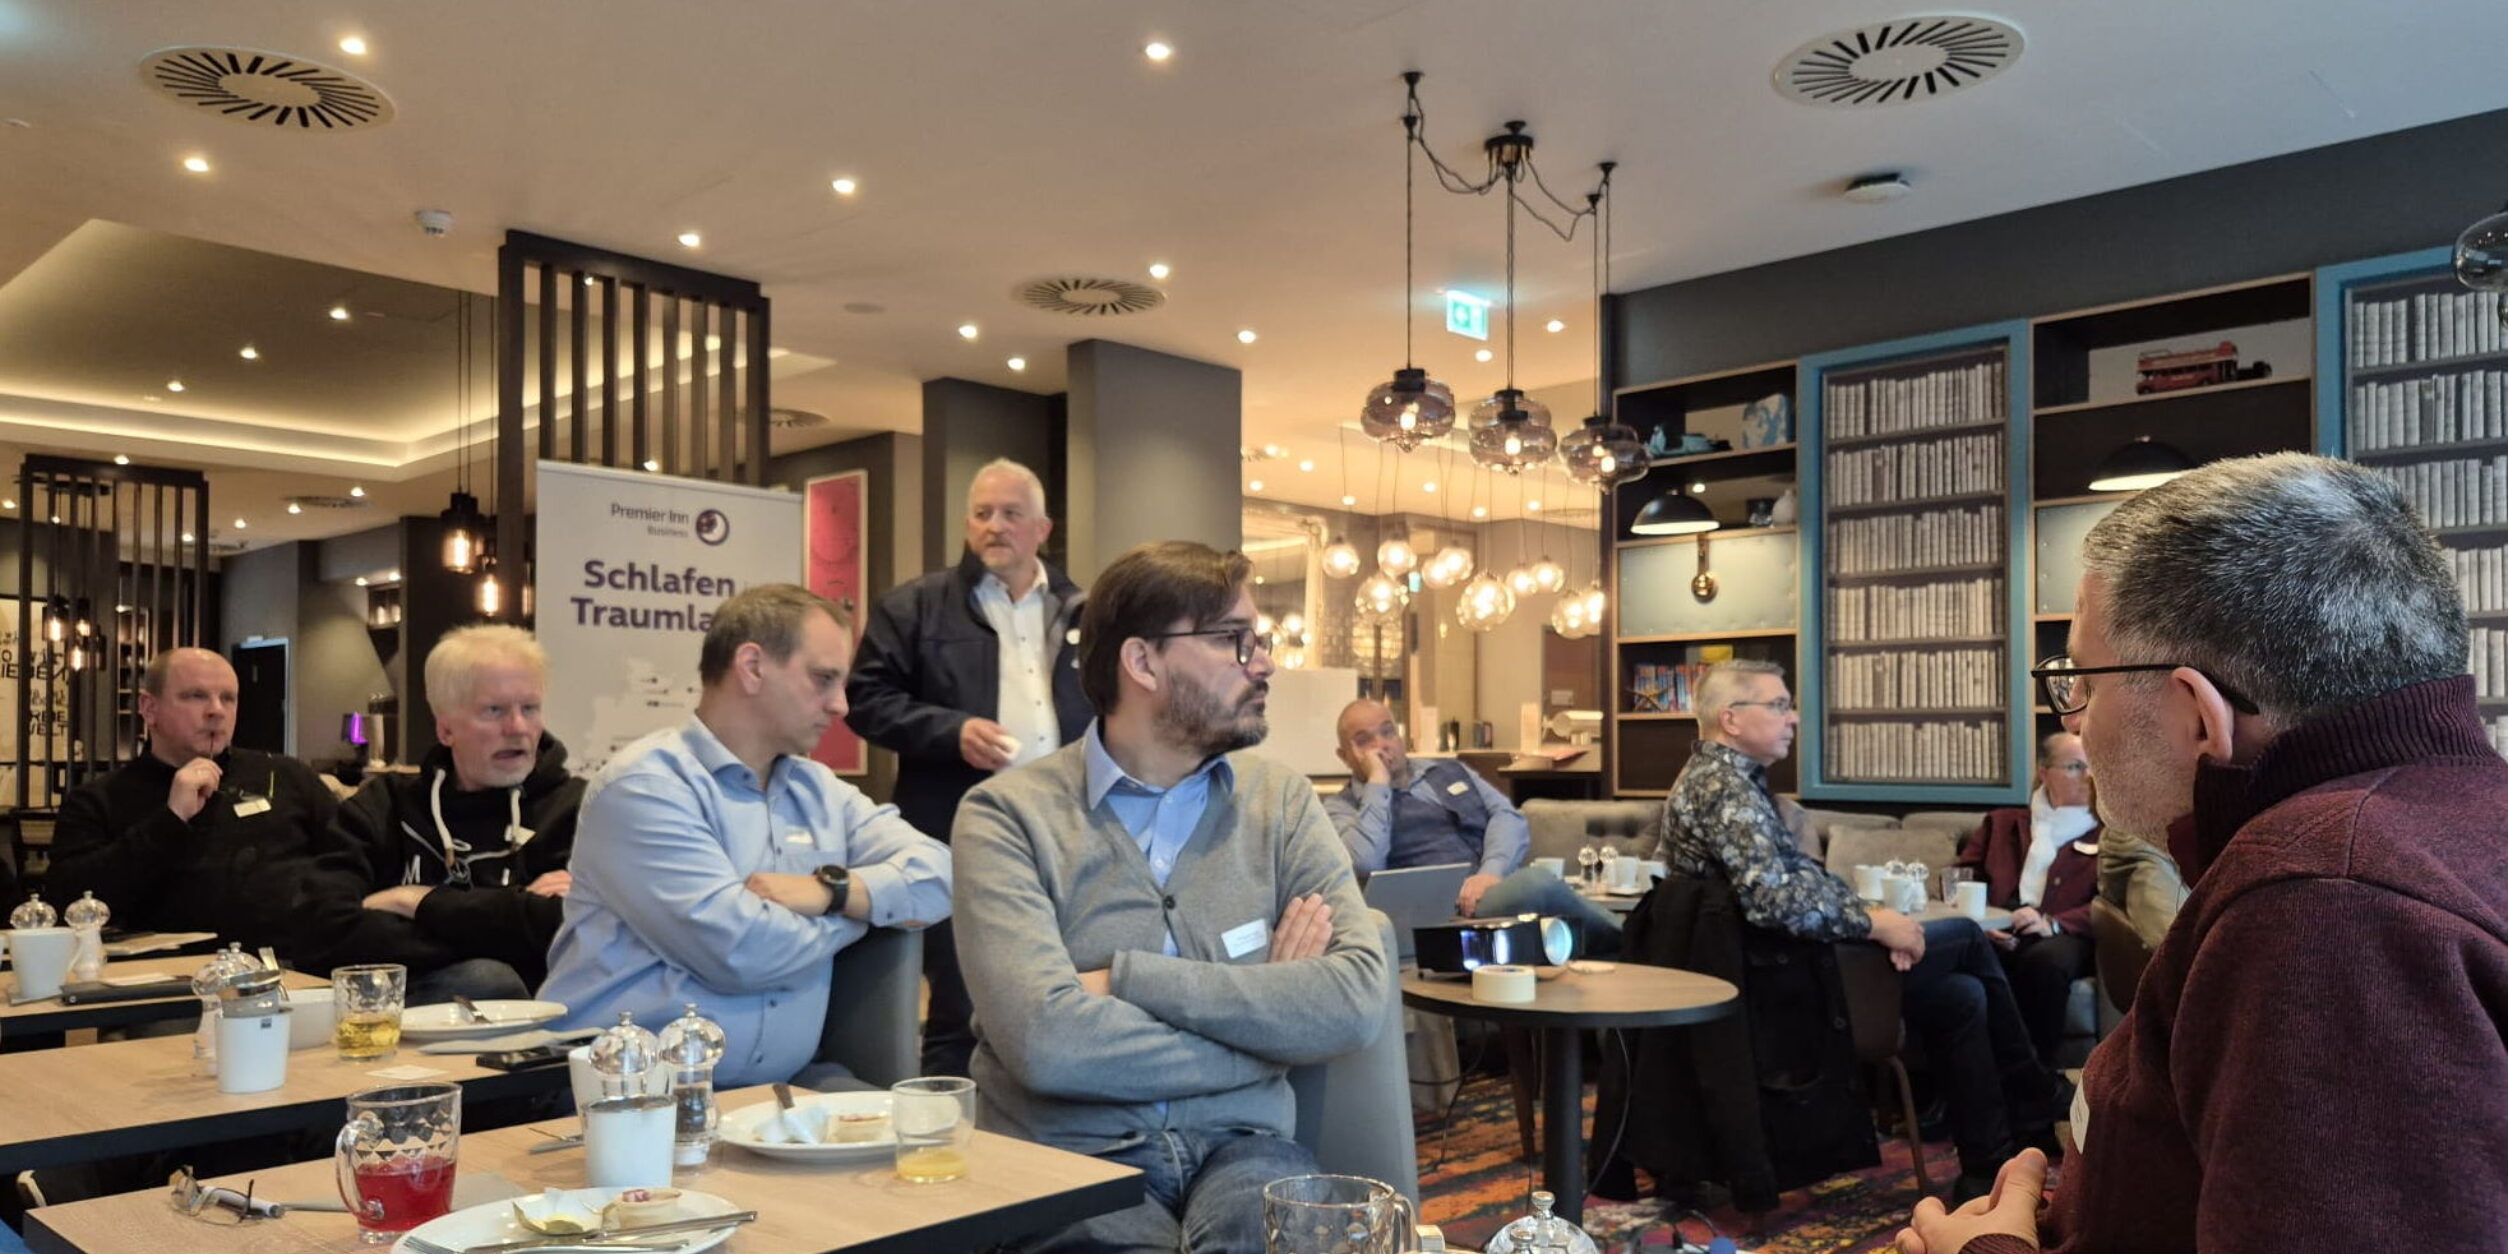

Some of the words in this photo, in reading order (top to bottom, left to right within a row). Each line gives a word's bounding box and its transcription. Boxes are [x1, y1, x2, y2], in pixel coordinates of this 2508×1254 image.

[611, 502, 665, 522] Premier
[669, 509, 689, 525] Inn
[647, 525, 689, 539] Business
[584, 559, 735, 597] Schlafen
